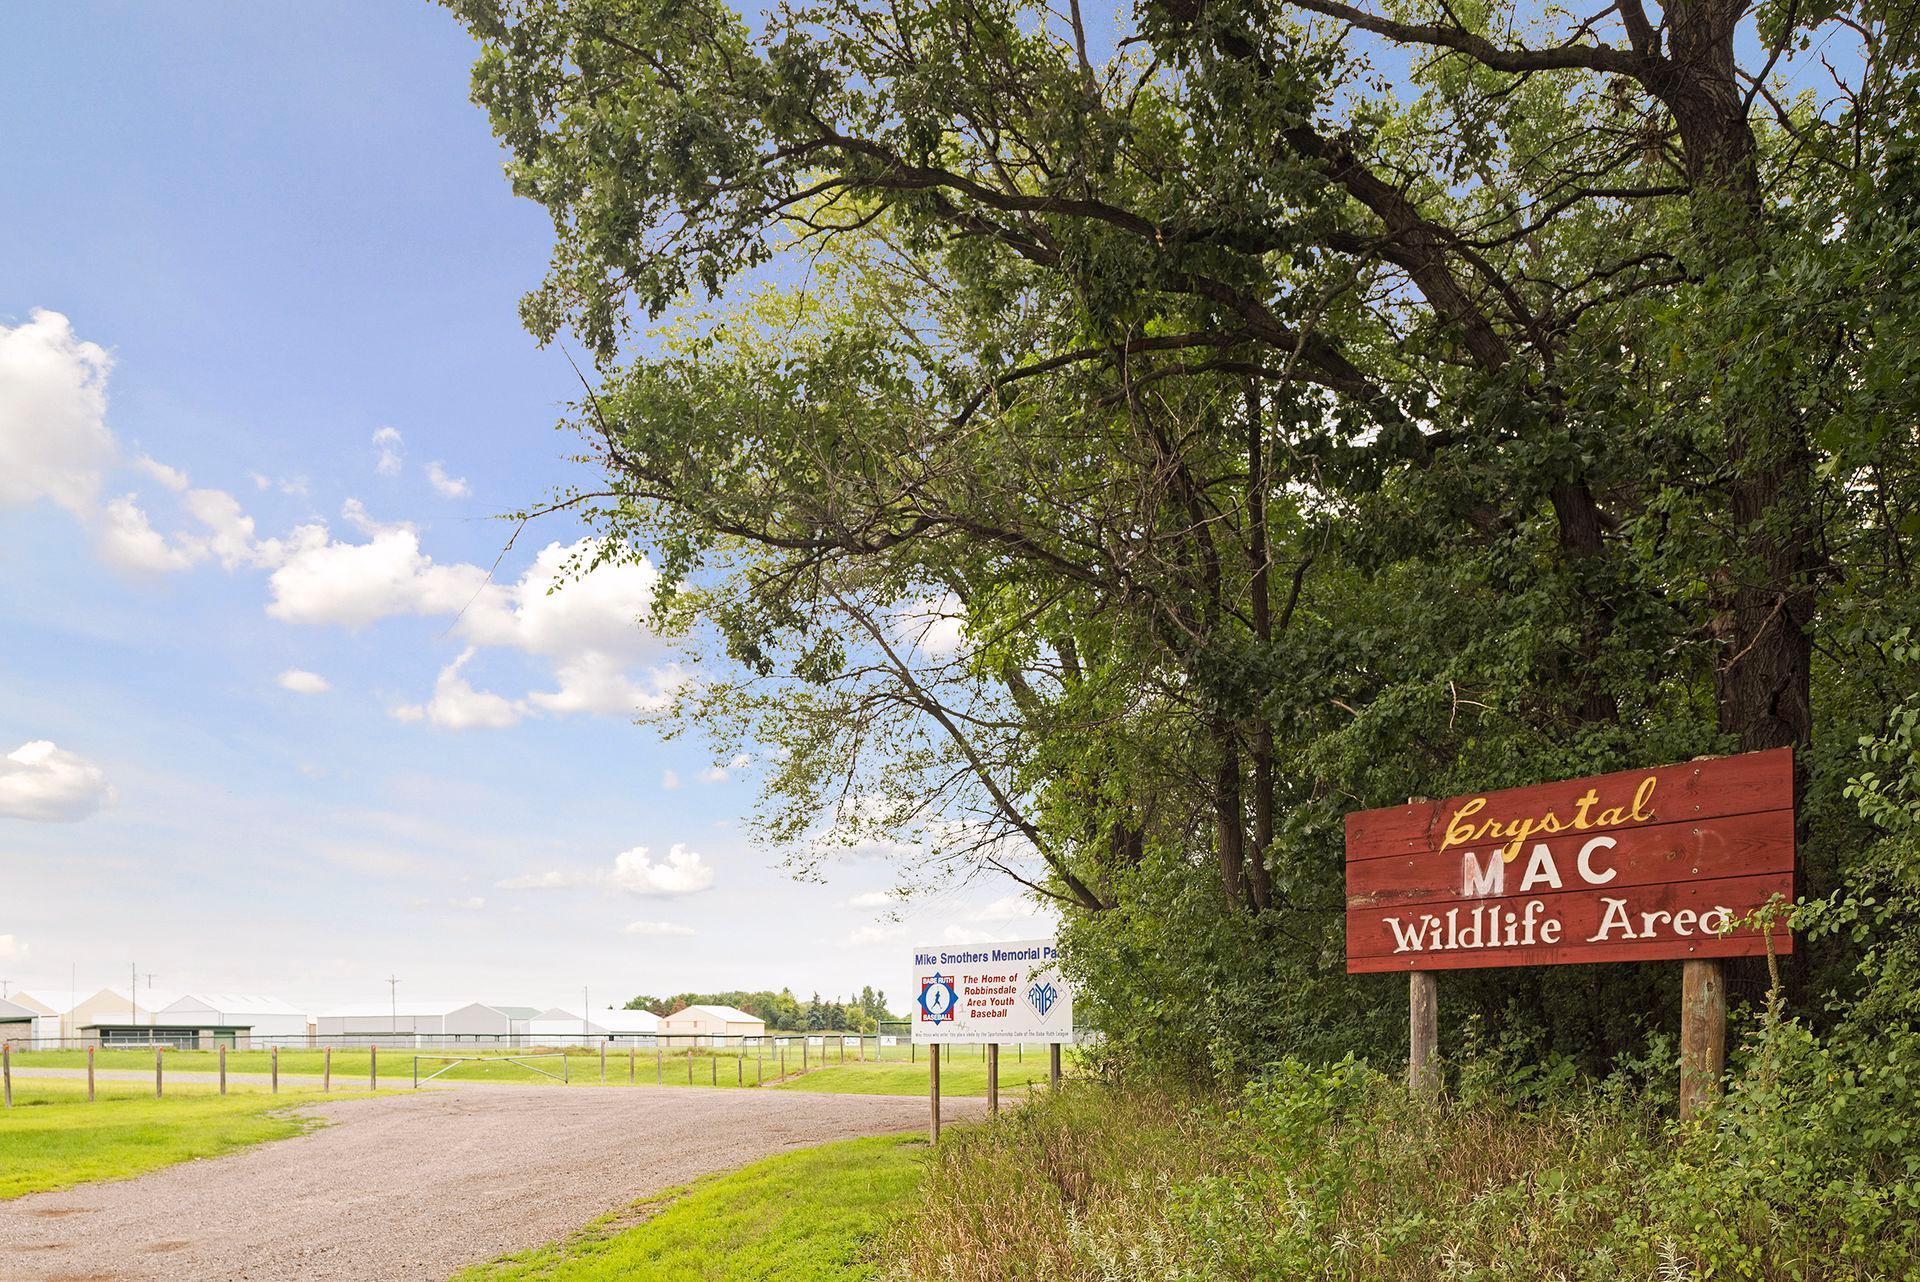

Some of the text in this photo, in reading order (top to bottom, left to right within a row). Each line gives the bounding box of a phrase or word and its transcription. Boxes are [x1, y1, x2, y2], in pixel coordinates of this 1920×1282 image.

[1439, 776, 1657, 863] Crystal
[1463, 836, 1617, 897] MAC
[1382, 897, 1734, 954] Wildlife Area
[915, 947, 1060, 965] Mike Smothers Memorial Pa
[963, 973, 1018, 984] The Home of
[964, 985, 1017, 995] Robbinsdale
[967, 997, 1015, 1007] Area Youth
[970, 1009, 1007, 1019] Baseball
